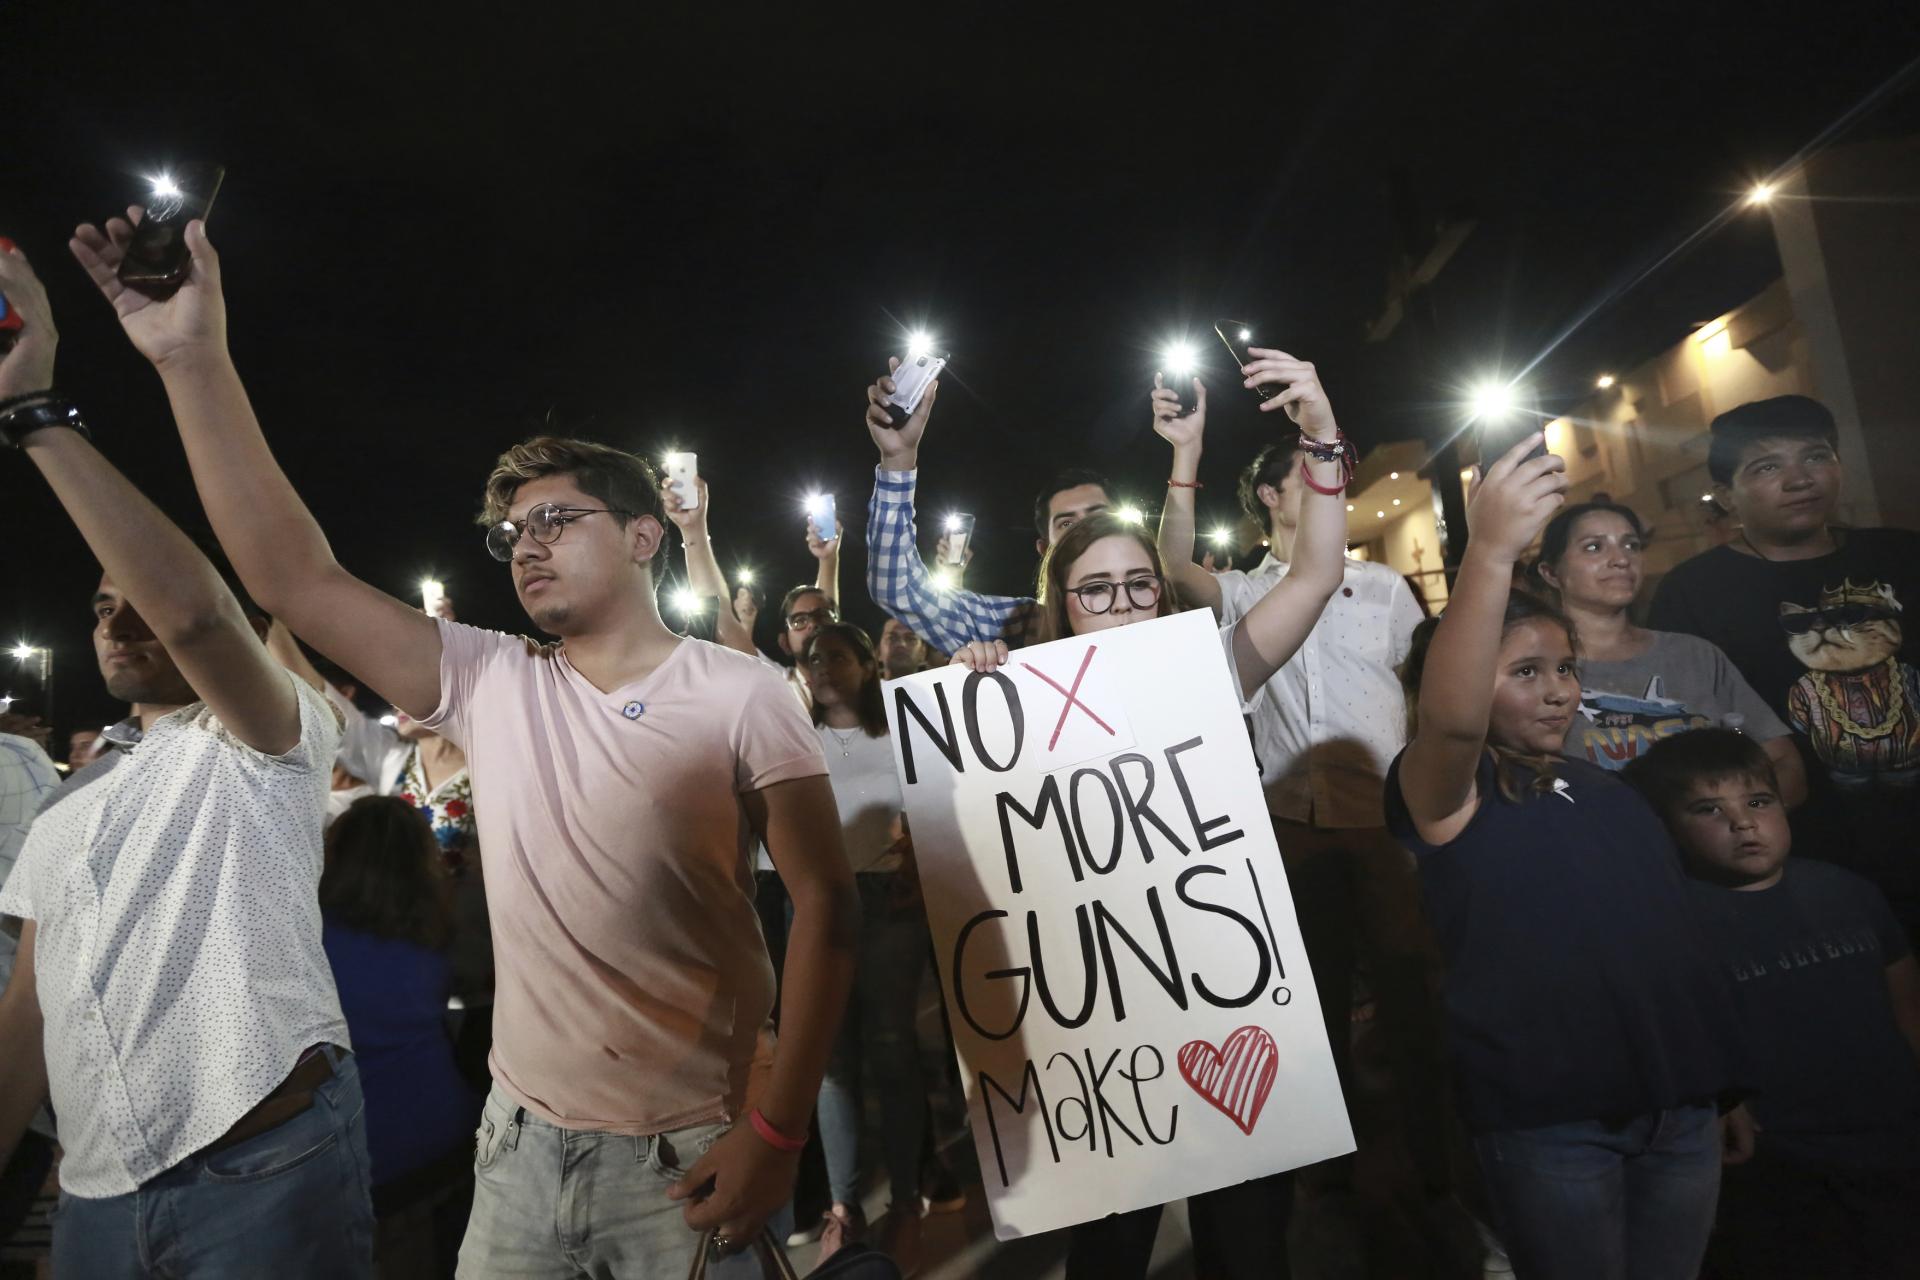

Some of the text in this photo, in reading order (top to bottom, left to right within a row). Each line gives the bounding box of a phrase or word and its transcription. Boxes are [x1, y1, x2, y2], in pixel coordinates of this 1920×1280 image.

[894, 669, 1025, 784] NO
[995, 735, 1245, 893] MORE
[952, 857, 1292, 1041] GUNS!
